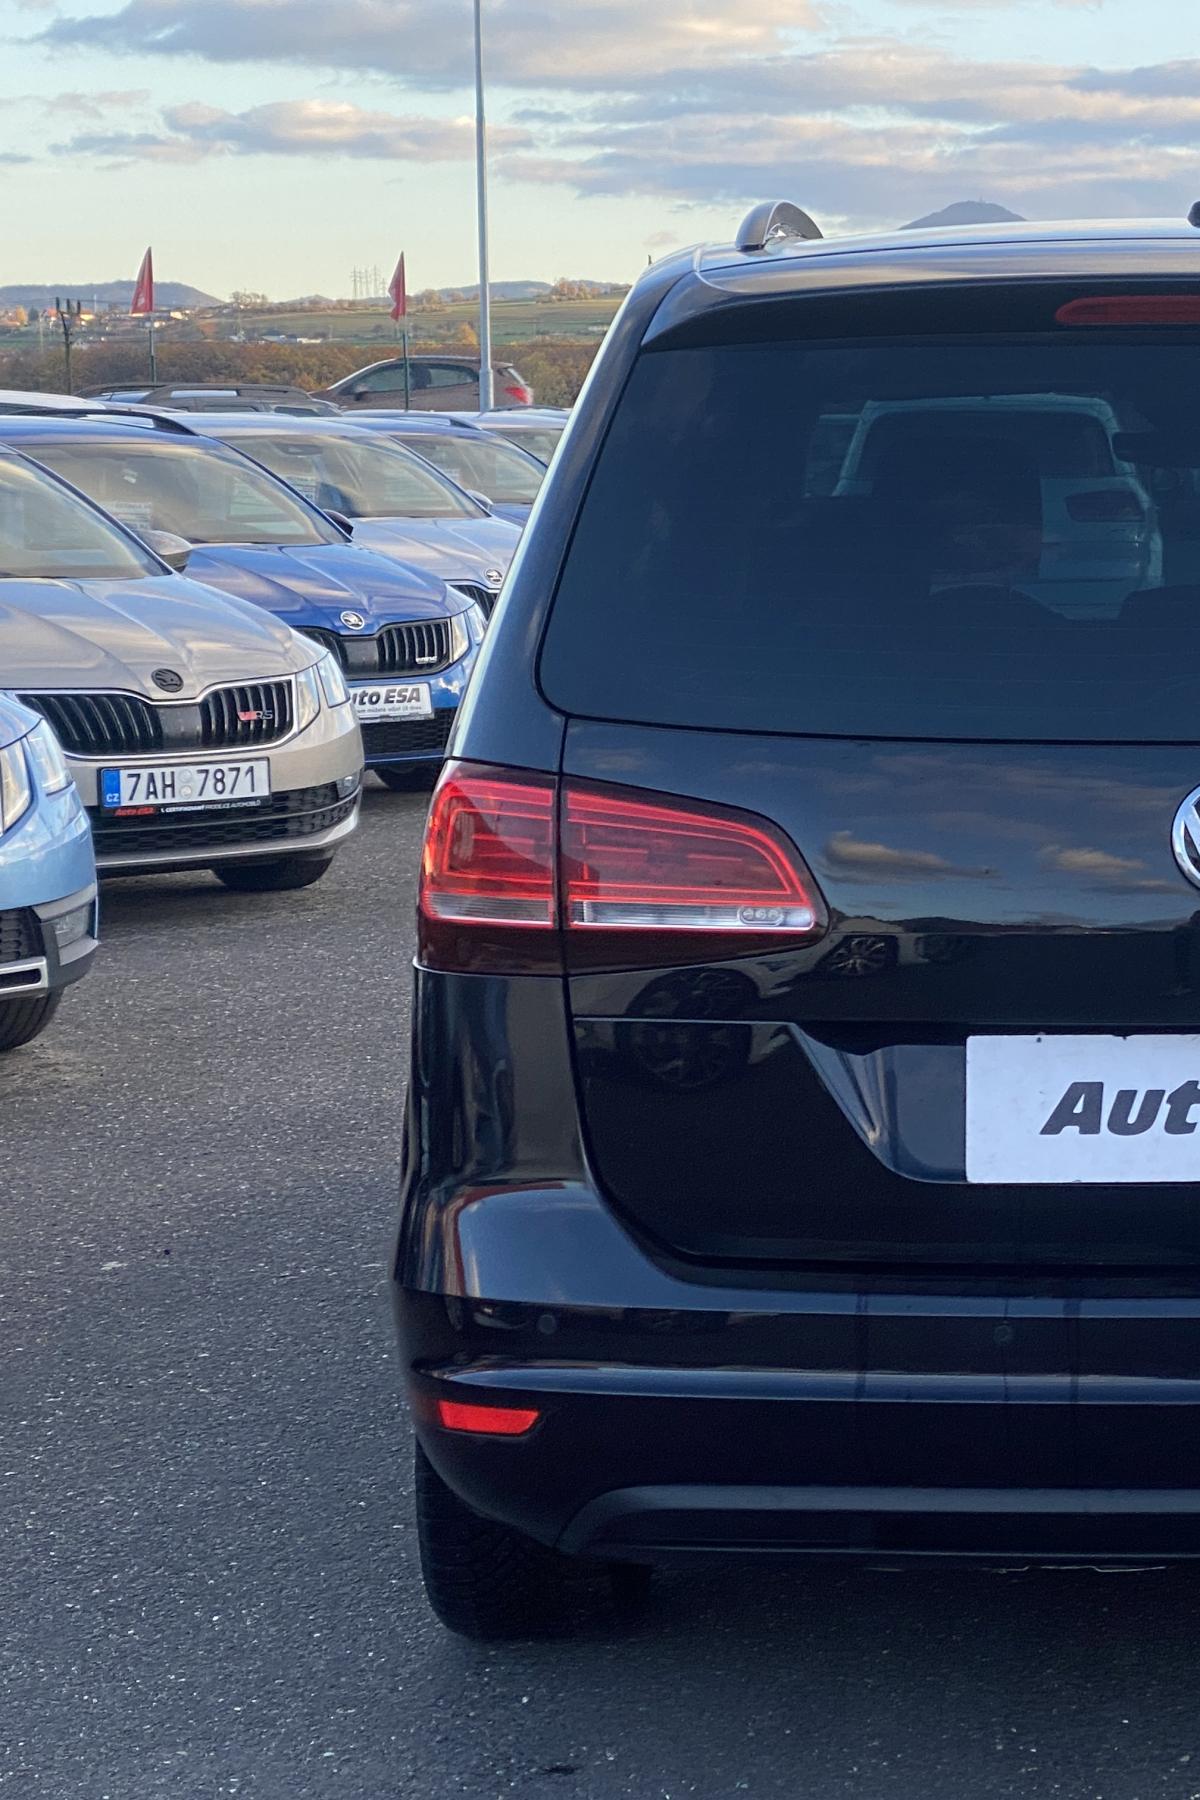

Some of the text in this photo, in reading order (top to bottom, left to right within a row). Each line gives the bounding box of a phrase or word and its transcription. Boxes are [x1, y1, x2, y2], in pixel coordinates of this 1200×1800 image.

[384, 687, 421, 704] ESA
[127, 765, 256, 801] 7AH 7871
[106, 792, 119, 803] CZ
